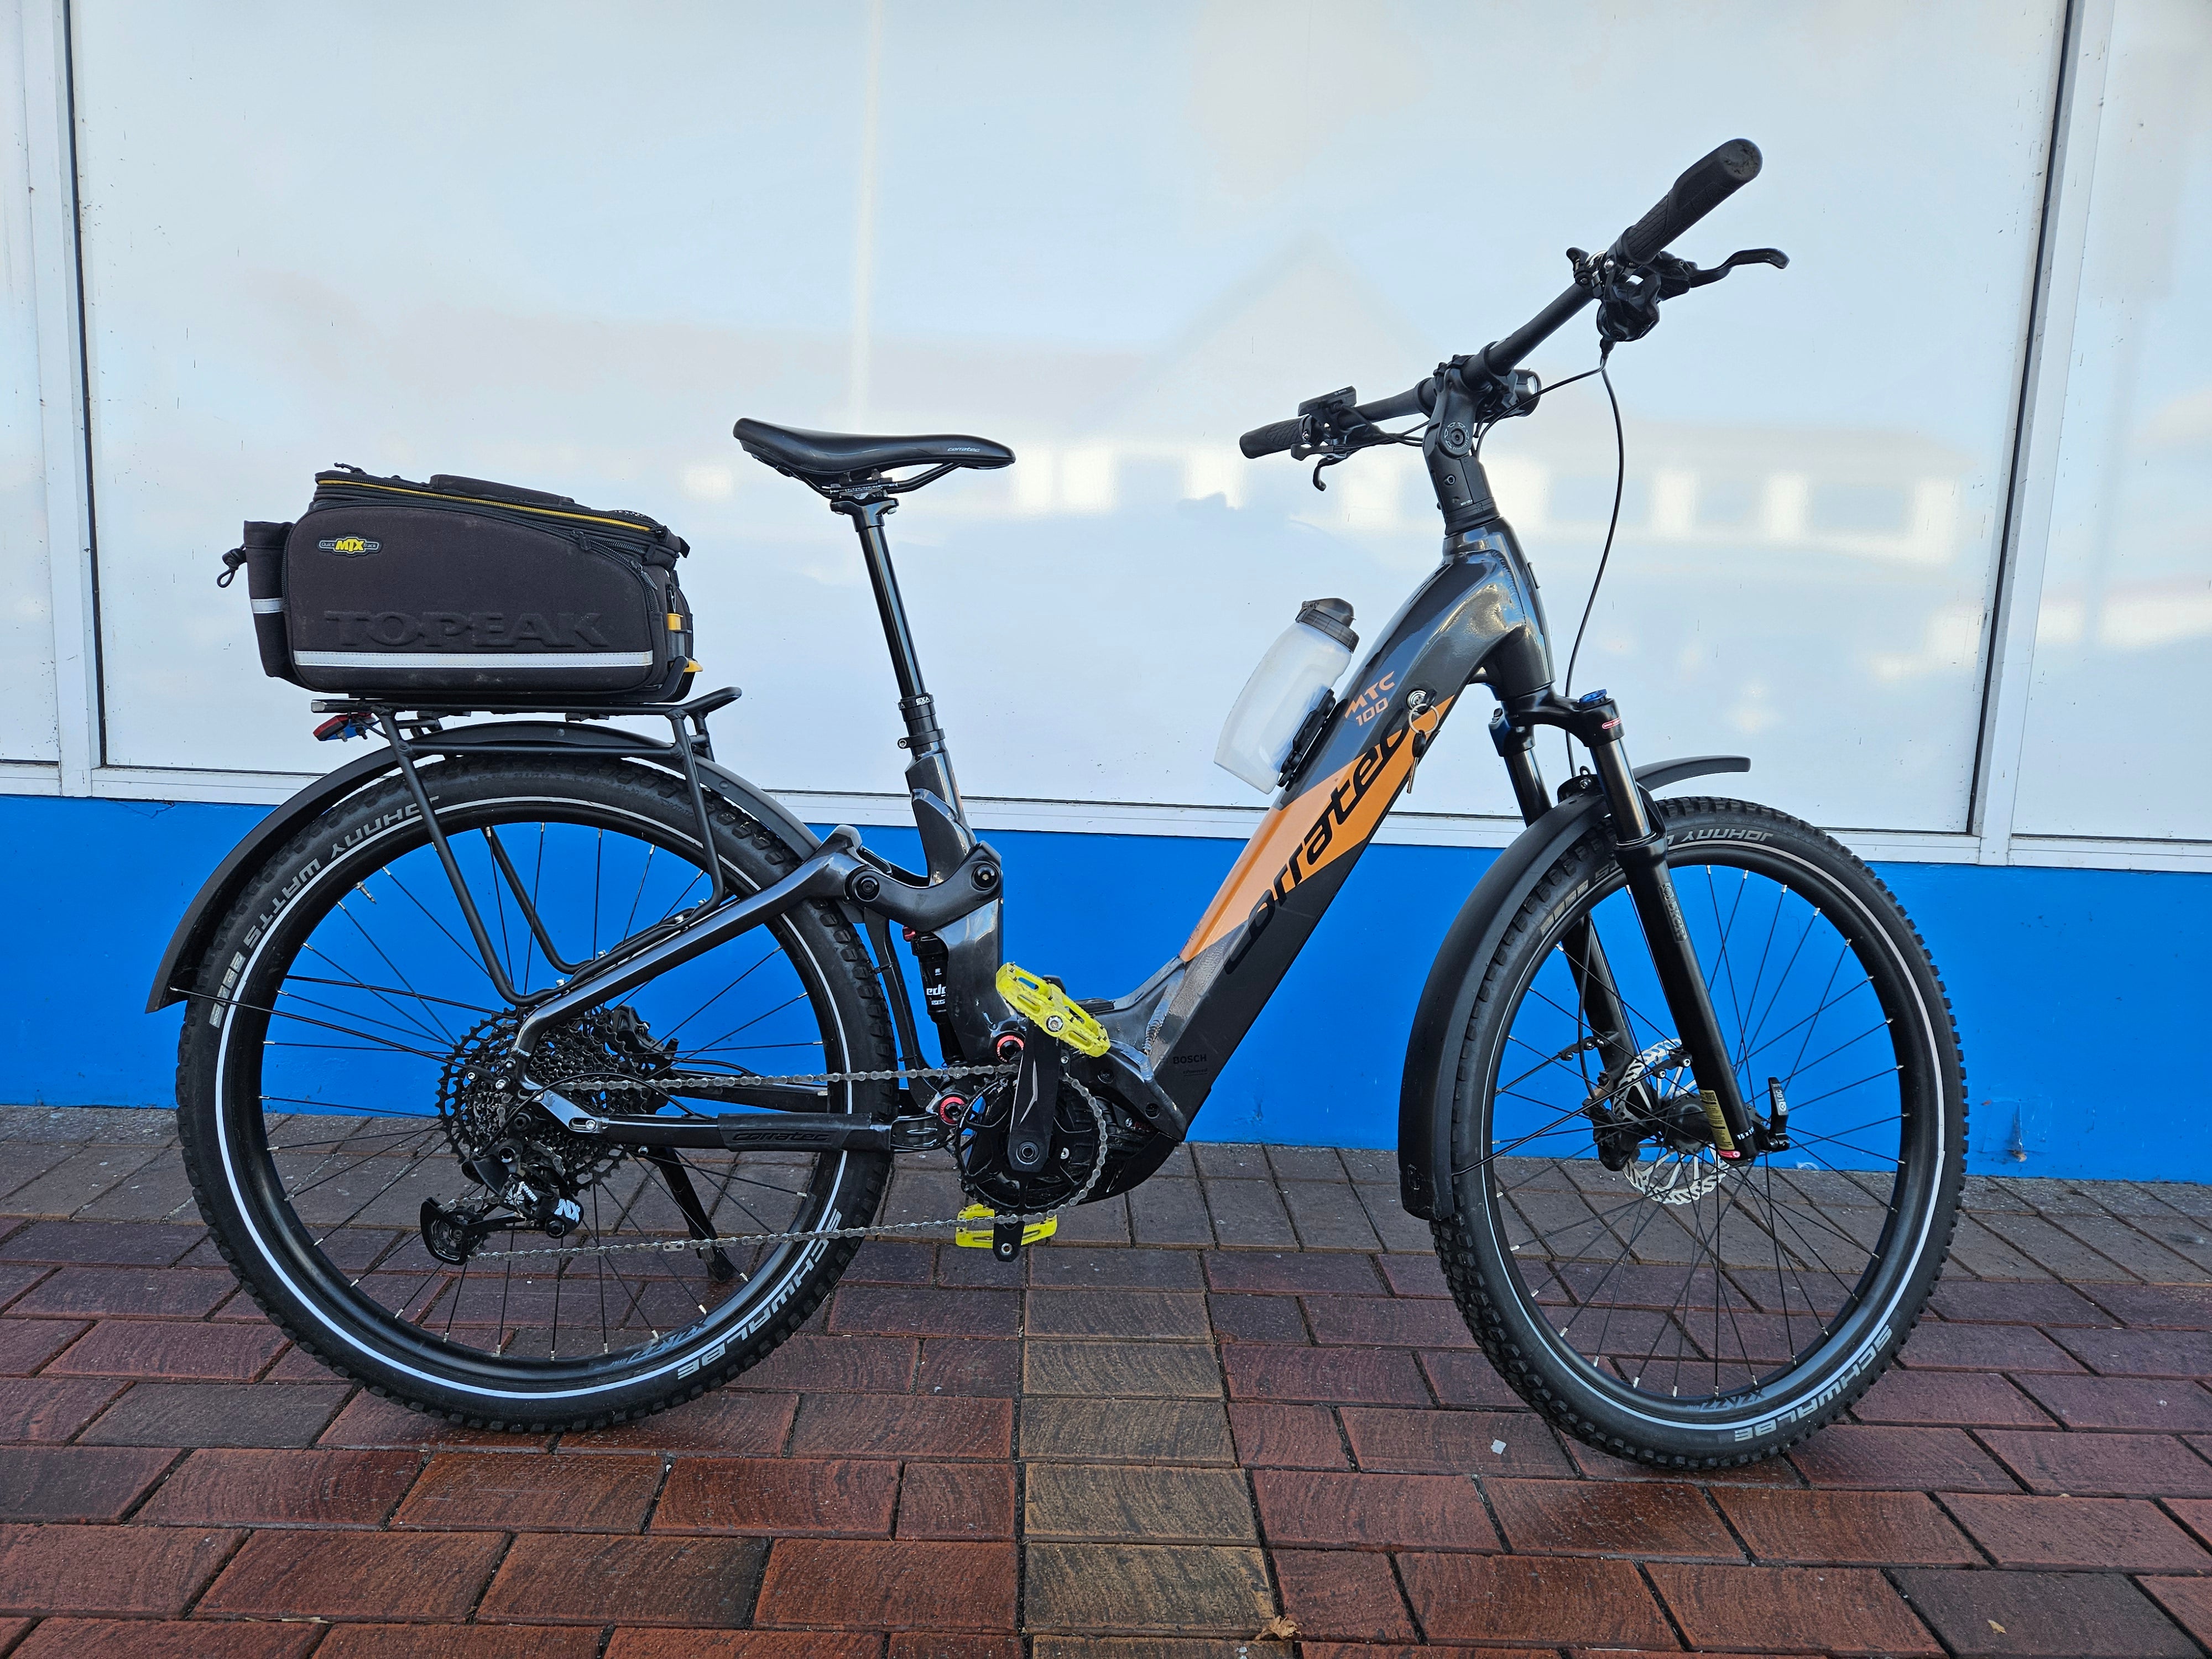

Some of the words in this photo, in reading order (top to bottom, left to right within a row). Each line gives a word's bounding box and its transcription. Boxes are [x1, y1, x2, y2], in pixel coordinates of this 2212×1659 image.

[335, 538, 364, 552] MTX
[324, 610, 609, 648] TOPEAK
[1344, 670, 1395, 718] MTC
[1355, 696, 1389, 727] 100
[1224, 707, 1411, 974] corratec
[1682, 828, 1775, 842] JOHNNY
[243, 858, 321, 950] WATTS
[1172, 1054, 1207, 1065] BOSCH
[732, 1131, 830, 1141] corratec
[554, 1198, 581, 1224] NX
[677, 1208, 842, 1380] SCHWALBE
[1734, 1324, 1893, 1442] SCHWALBE
